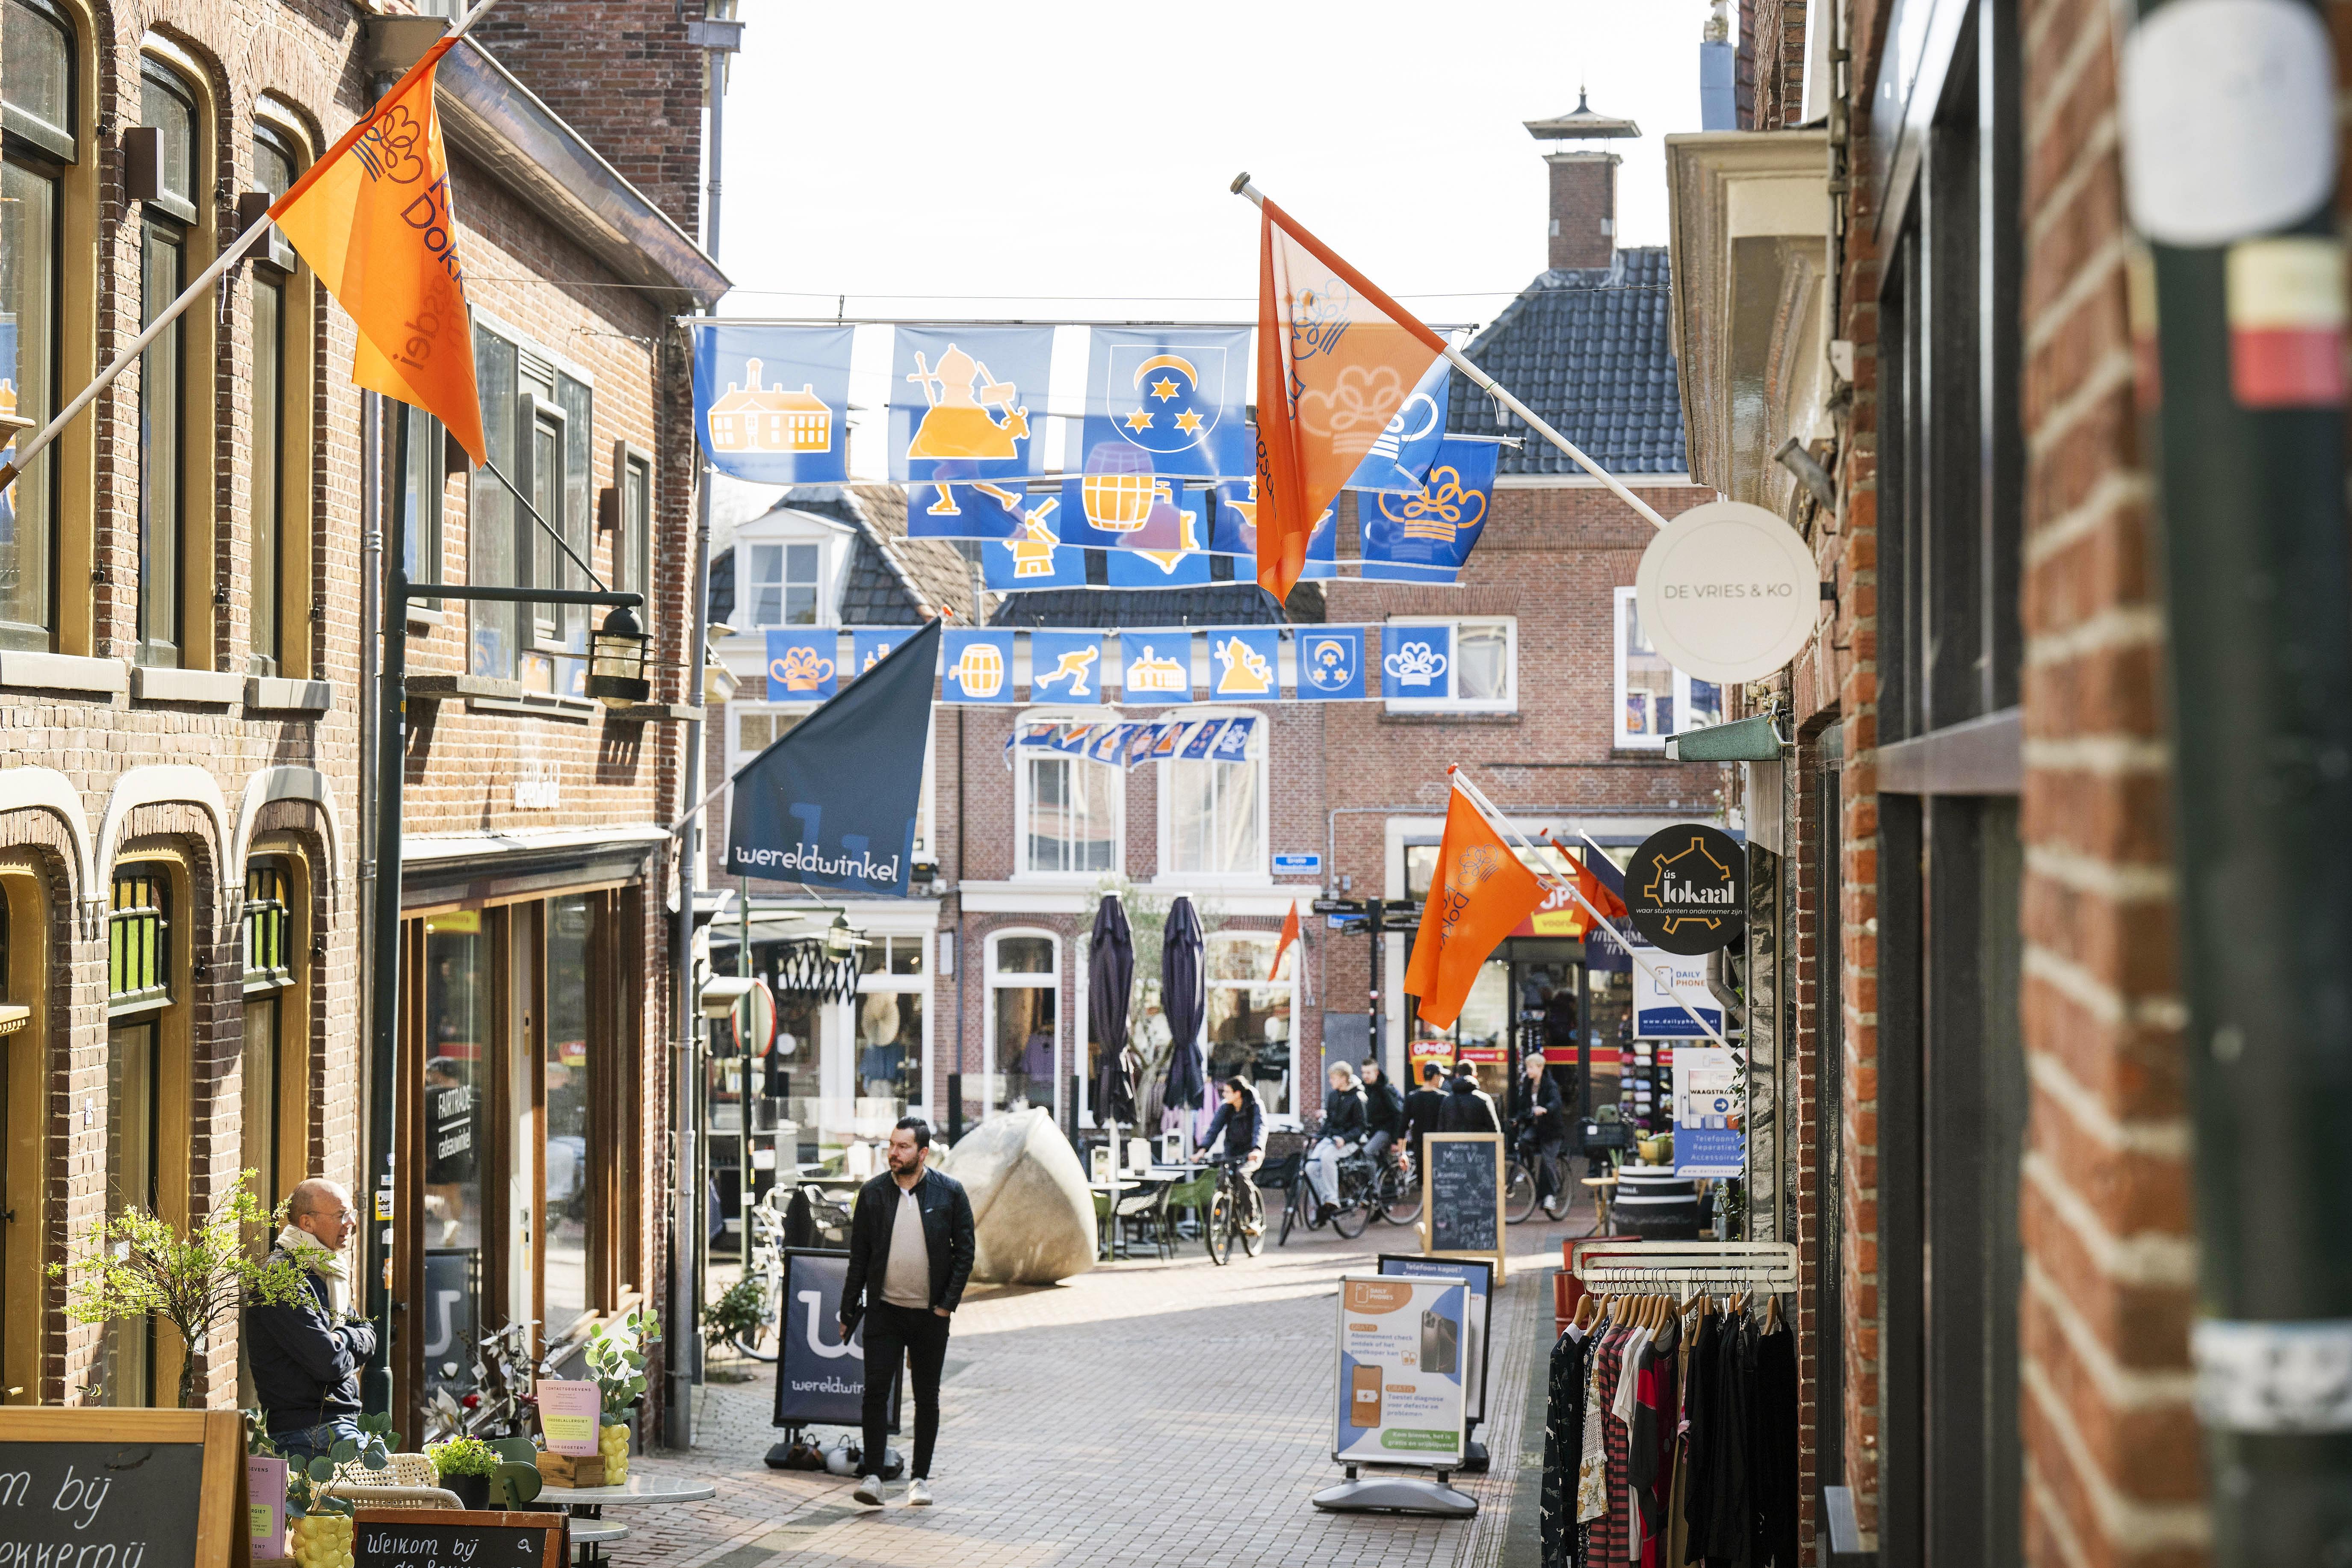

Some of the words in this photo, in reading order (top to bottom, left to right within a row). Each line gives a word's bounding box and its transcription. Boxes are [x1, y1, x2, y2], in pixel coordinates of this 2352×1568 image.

[400, 192, 467, 306] Dokk
[1665, 585, 1689, 599] DE
[1694, 584, 1745, 599] VRIES
[1750, 584, 1761, 598] &
[1767, 583, 1792, 597] KO
[735, 843, 898, 883] wereldwinkel
[1664, 870, 1676, 879] ús
[1664, 880, 1734, 904] lokaal
[438, 1084, 471, 1120] FAIRTRADE
[438, 1125, 471, 1160] cadeauwinkel
[792, 1376, 865, 1394] wereldwin
[366, 1533, 438, 1555] Welkom
[452, 1539, 479, 1562] bij
